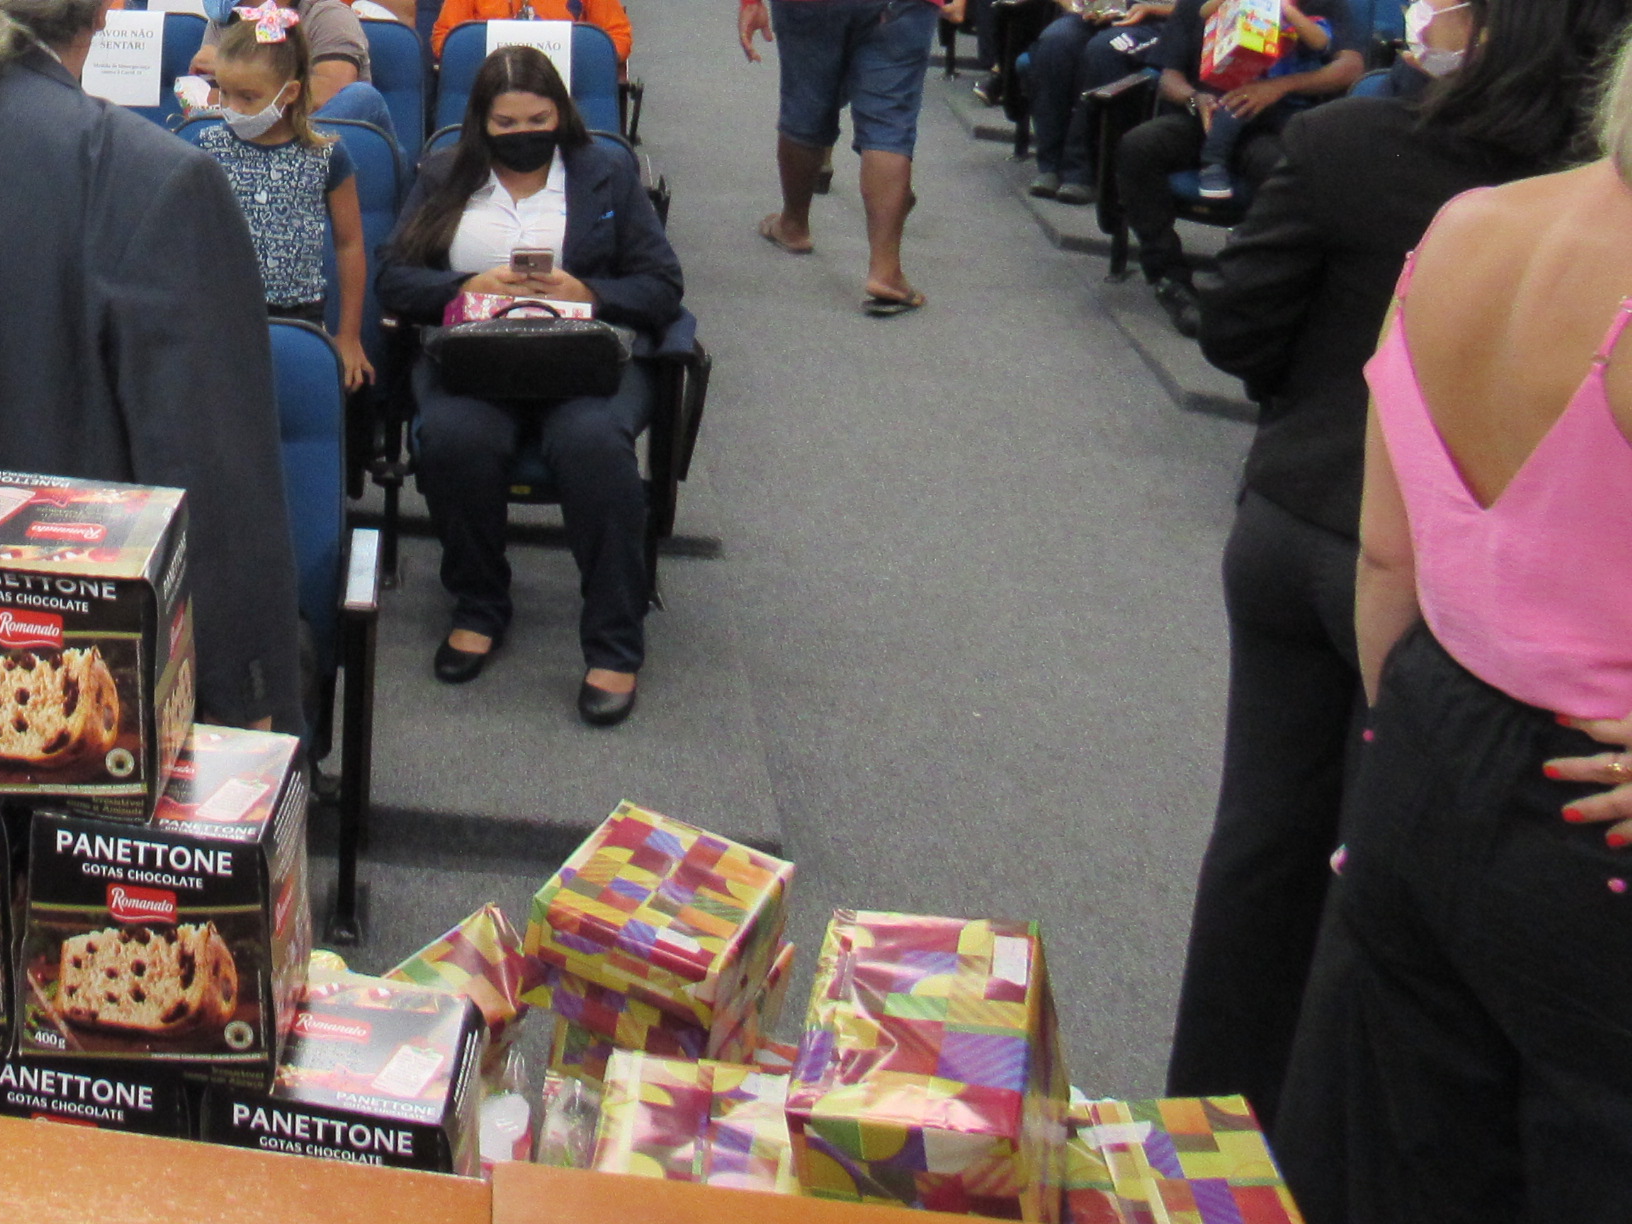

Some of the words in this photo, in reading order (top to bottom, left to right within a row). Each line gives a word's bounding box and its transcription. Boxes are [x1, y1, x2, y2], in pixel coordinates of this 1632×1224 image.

[100, 40, 146, 50] SENTAR!
[130, 28, 154, 39] NÃO
[536, 40, 562, 51] NÃO
[15, 591, 90, 613] CHOCOLATE
[57, 830, 233, 876] PANETTONE
[82, 862, 123, 880] GOTAS
[127, 868, 203, 889] CHOCOLATE
[111, 886, 174, 914] Romanato
[296, 1012, 366, 1039] Romanato
[6, 1091, 48, 1109] GOTAS
[51, 1098, 125, 1123] CHOCOLATE
[233, 1103, 415, 1156] PANETTONE
[258, 1135, 304, 1153] GOTAS
[306, 1143, 384, 1167] CHOCOLATE
